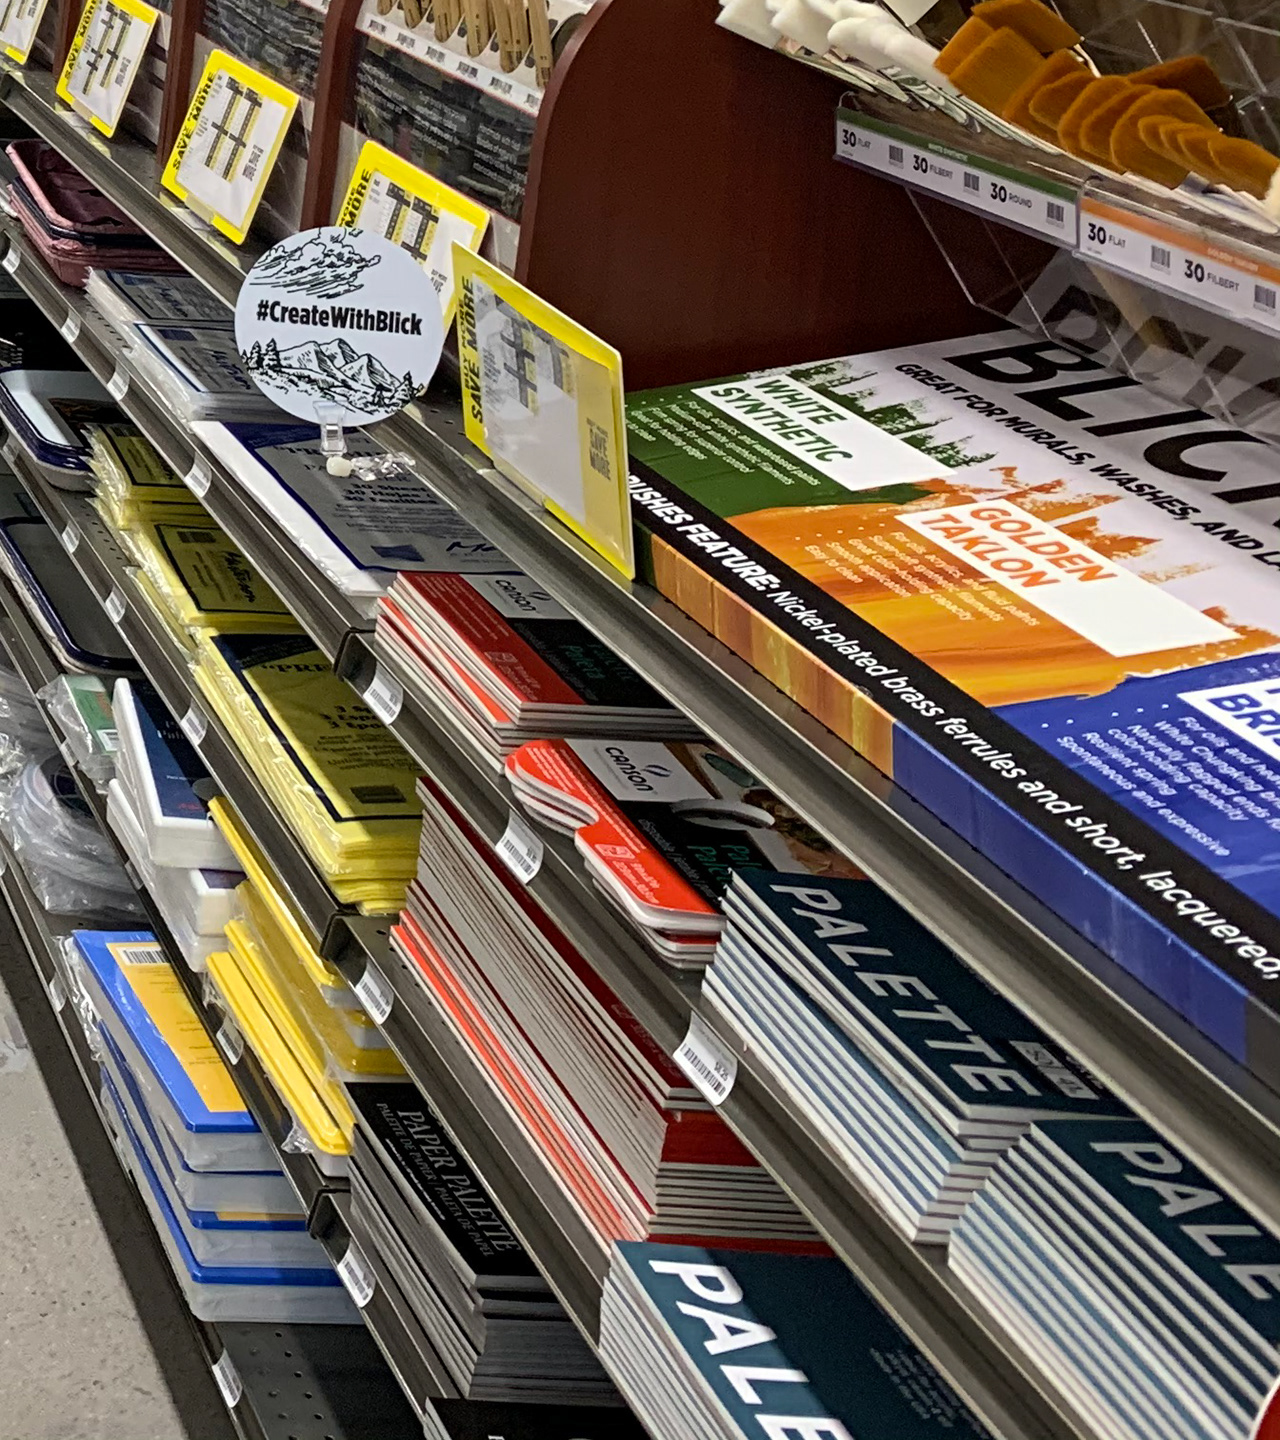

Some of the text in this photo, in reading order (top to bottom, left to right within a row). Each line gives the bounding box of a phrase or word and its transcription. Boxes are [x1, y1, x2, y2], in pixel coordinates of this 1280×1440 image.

[171, 71, 216, 171] SAVE MORE
[344, 168, 373, 229] MORE
[842, 128, 1033, 209] 30 FLAT 30 FILBERT 30 ROUND
[1087, 221, 1240, 294] 30 FLAT 30 FILBERT
[256, 299, 423, 337] #CreateWithBlick
[461, 275, 485, 425] SAVE MORE
[710, 386, 855, 464] SYNTHETIC
[754, 379, 848, 426] WHITE
[894, 363, 1265, 551] GREAT FOR MURALS, WASHES, AND
[804, 545, 865, 584] Easy clean
[826, 541, 912, 599] Smooth application
[847, 538, 976, 622] Great color-holding capacity
[869, 535, 1005, 623] Super-soft synthetic filaments
[920, 513, 1061, 589] TAKLON
[970, 506, 1118, 583] GOLDEN
[493, 578, 536, 613] canson
[980, 588, 1009, 609] fluid
[1003, 601, 1041, 627] paints
[676, 524, 781, 593] FEATURE:
[766, 591, 890, 678] Nickel-plated
[882, 676, 945, 718] brass
[934, 715, 1028, 782] ferrules
[1017, 779, 1084, 817] and
[1064, 814, 1147, 871] short,
[1178, 716, 1230, 748] For oils
[603, 745, 658, 792] canson
[1082, 731, 1178, 797] Resilient spring
[1107, 728, 1249, 822] color-holding capacity
[1127, 723, 1187, 762] Naturally
[1183, 760, 1238, 797] flagged
[1232, 794, 1271, 820] ends
[1154, 720, 1195, 747] White
[1191, 745, 1265, 793] Chungking
[1057, 735, 1231, 858] Spontaneous and expressive
[768, 882, 1045, 1099] PALETTE
[376, 1102, 407, 1138] PALETTE
[399, 1137, 417, 1151] DE
[397, 1110, 523, 1252] PAPER PALETTE
